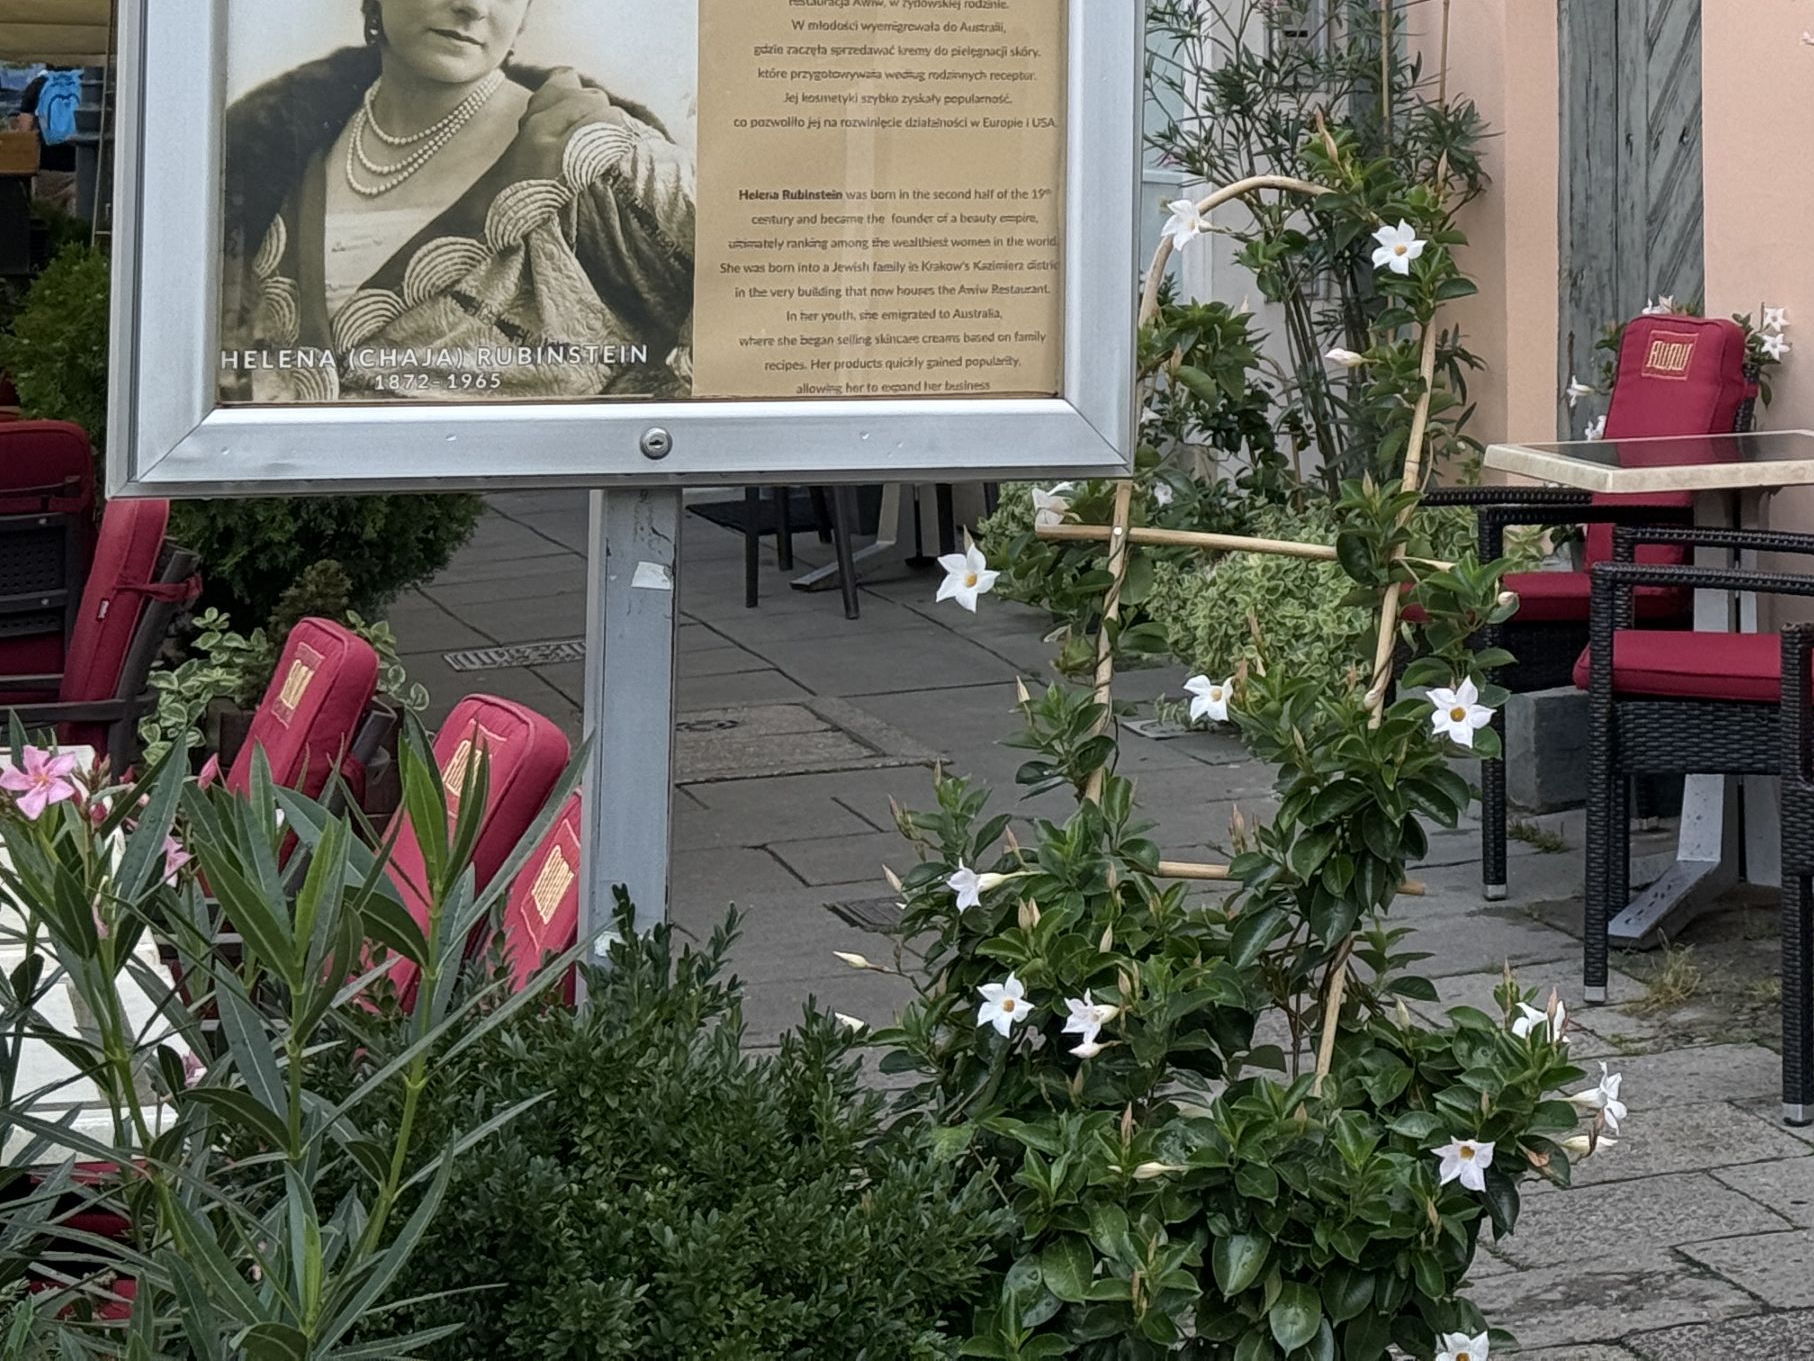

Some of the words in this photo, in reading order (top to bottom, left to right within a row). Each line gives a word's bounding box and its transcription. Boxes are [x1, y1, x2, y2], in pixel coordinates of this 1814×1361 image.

[942, 22, 959, 32] do
[753, 44, 784, 56] gdzie
[897, 46, 932, 57] kremy
[933, 46, 949, 56] do
[950, 46, 1008, 58] pielęgnacji
[757, 68, 788, 78] które
[783, 93, 799, 105] Jej
[801, 93, 859, 105] kosmetyki
[860, 93, 900, 105] szybko
[733, 119, 748, 127] co
[806, 117, 822, 129] jej
[823, 119, 838, 127] na
[982, 117, 1024, 129] Europie
[738, 189, 780, 200] Helena
[781, 189, 844, 200] Rubinstein
[870, 190, 897, 199] born
[898, 190, 910, 199] in
[912, 190, 931, 199] the
[932, 189, 972, 199] second
[973, 189, 995, 199] half
[996, 189, 1009, 199] of
[1010, 188, 1029, 199] the
[750, 215, 795, 227] century
[796, 214, 818, 224] and
[820, 214, 865, 224] became
[866, 214, 886, 224] the
[891, 213, 935, 224] founder
[936, 213, 949, 223] of
[959, 213, 998, 225] beauty
[786, 238, 829, 250] ranking
[830, 240, 870, 250] among
[871, 237, 891, 247] the
[993, 238, 1004, 246] in
[1006, 236, 1025, 246] the
[719, 263, 742, 273] She
[742, 265, 766, 273] was
[767, 263, 796, 273] born
[797, 263, 821, 272] into
[831, 262, 870, 272] Jewish
[872, 261, 906, 273] family
[907, 262, 920, 272] in
[734, 287, 746, 297] in
[748, 287, 768, 298] the
[769, 289, 795, 299] very
[797, 287, 843, 299] building
[844, 286, 868, 296] that
[869, 288, 895, 296] now
[896, 285, 936, 296] houses
[937, 286, 957, 295] the
[957, 285, 989, 295] Awiw
[786, 311, 798, 321] In
[799, 312, 820, 321] her
[858, 312, 879, 320] she
[880, 309, 937, 322] emigrated
[938, 310, 951, 319] to
[738, 336, 776, 346] where
[777, 336, 798, 345] she
[836, 335, 873, 346] selling
[874, 334, 920, 344] skincare
[921, 335, 961, 343] creams
[963, 332, 995, 343] based
[997, 334, 1012, 342] on
[1013, 331, 1046, 342] family
[220, 346, 337, 370] HELENA
[348, 346, 464, 371] (CHAJA)
[476, 343, 649, 367] RUBINSTEIN
[810, 359, 832, 369] Her
[833, 359, 883, 372] products
[884, 357, 925, 370] quickly
[926, 356, 963, 369] gained
[845, 383, 865, 392] her
[866, 383, 881, 392] to
[923, 381, 945, 391] her
[944, 381, 993, 390] business
